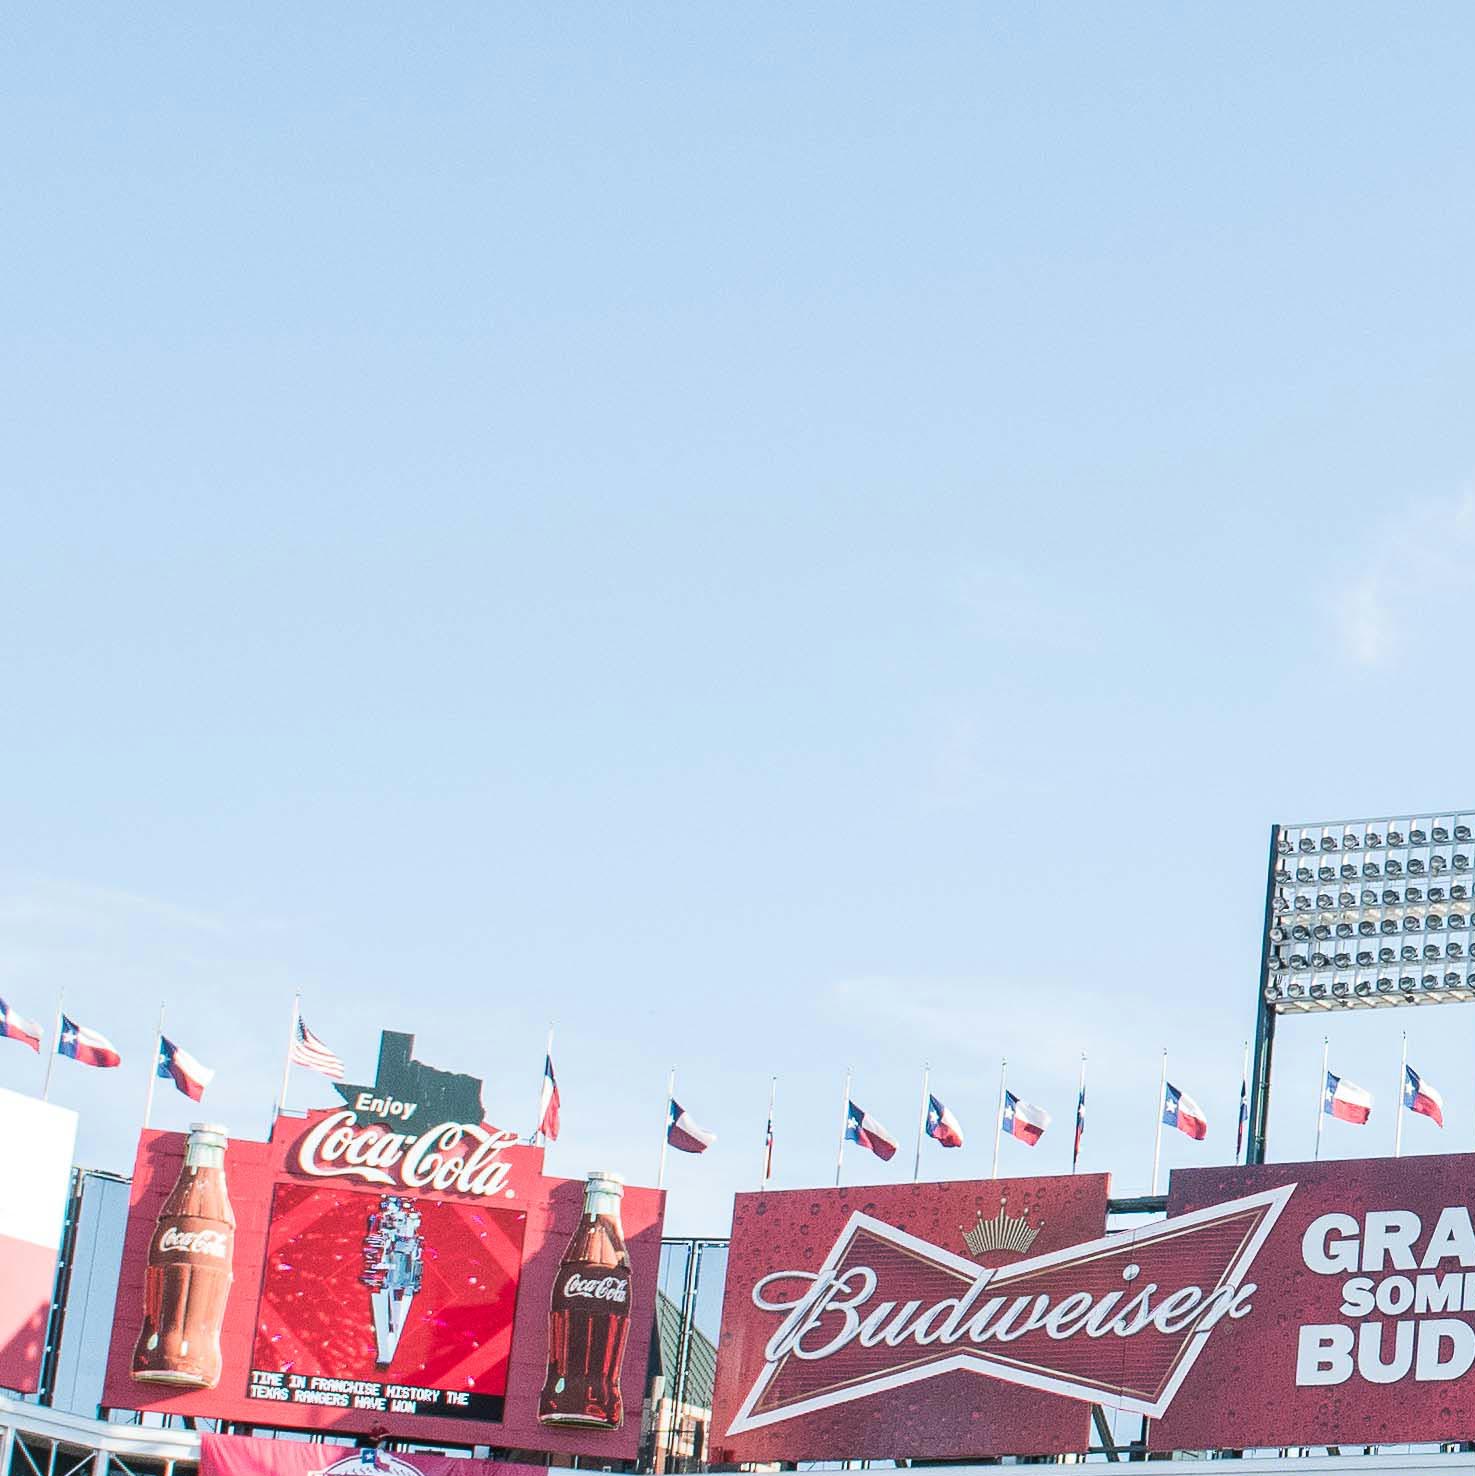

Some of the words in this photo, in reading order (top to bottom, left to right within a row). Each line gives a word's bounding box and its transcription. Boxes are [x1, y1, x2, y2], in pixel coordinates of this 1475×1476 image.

[355, 1092, 417, 1121] Enjoy
[752, 1263, 1258, 1363] Budweiser
[250, 1385, 290, 1400] TEXAS
[294, 1390, 350, 1408] RANGERS
[353, 1396, 387, 1411] HAVE
[390, 1400, 417, 1414] WON
[251, 1371, 284, 1387] TIME
[289, 1375, 307, 1389] IN
[310, 1377, 382, 1397] FRANCHISE
[385, 1385, 441, 1402] HISTORY
[446, 1391, 470, 1406] THE
